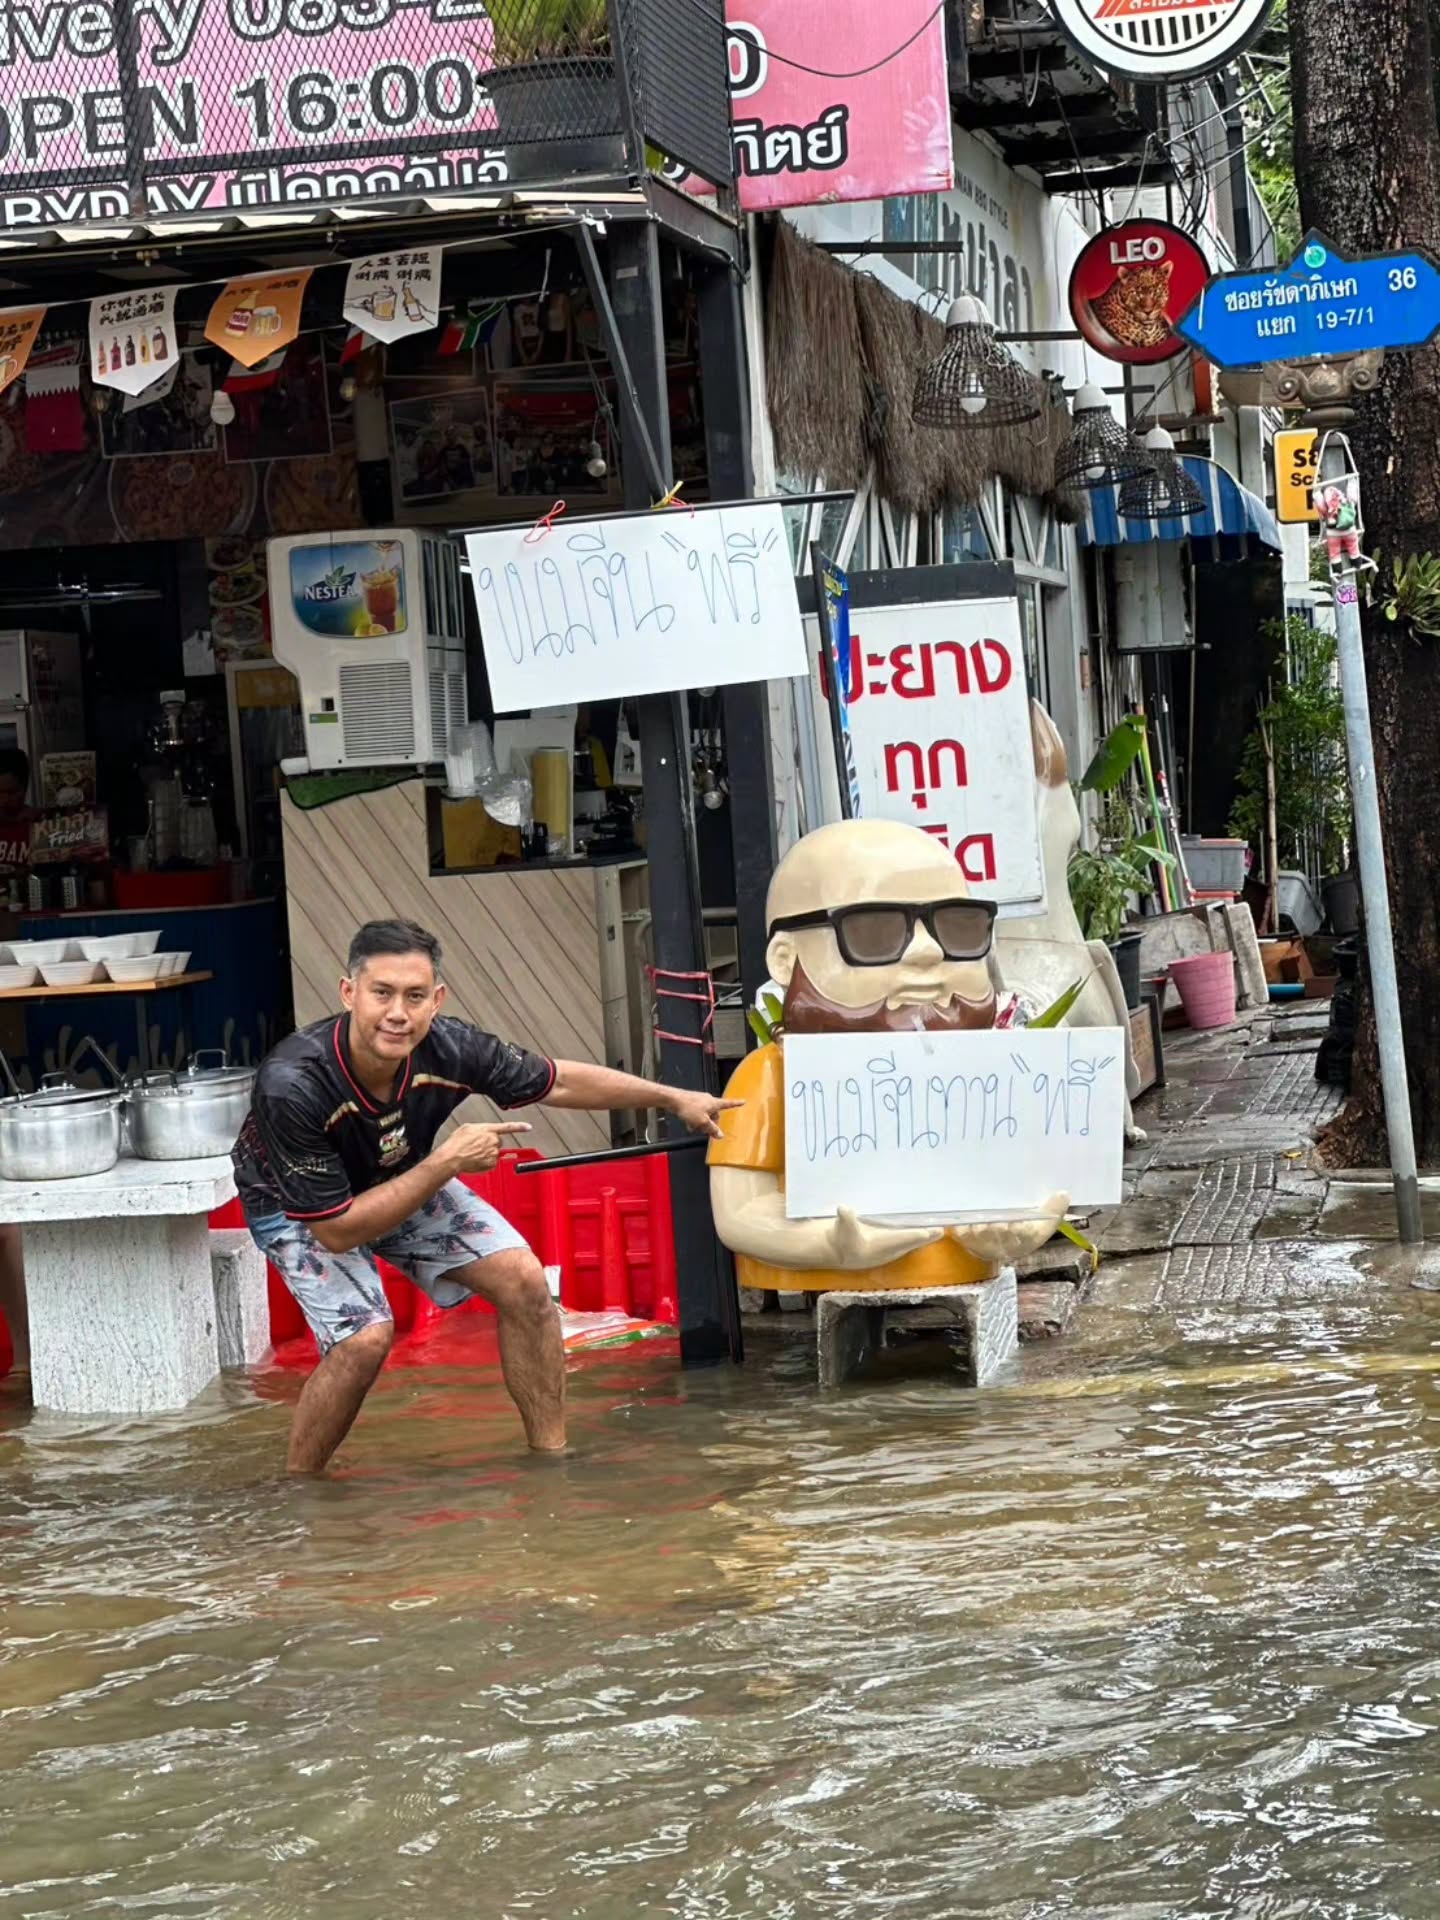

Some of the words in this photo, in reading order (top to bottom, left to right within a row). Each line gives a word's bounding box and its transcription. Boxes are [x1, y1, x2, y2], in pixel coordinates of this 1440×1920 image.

[0, 79, 200, 160] PEN
[1109, 236, 1165, 264] LEO
[1224, 273, 1358, 312] ซอยรัชดาภิเษก
[1388, 266, 1417, 291] 36
[1256, 316, 1297, 338] แยก
[1315, 306, 1375, 330] 19-7/1
[303, 584, 358, 601] NESTEA
[884, 738, 968, 810] ทุก
[48, 826, 85, 849] Fried
